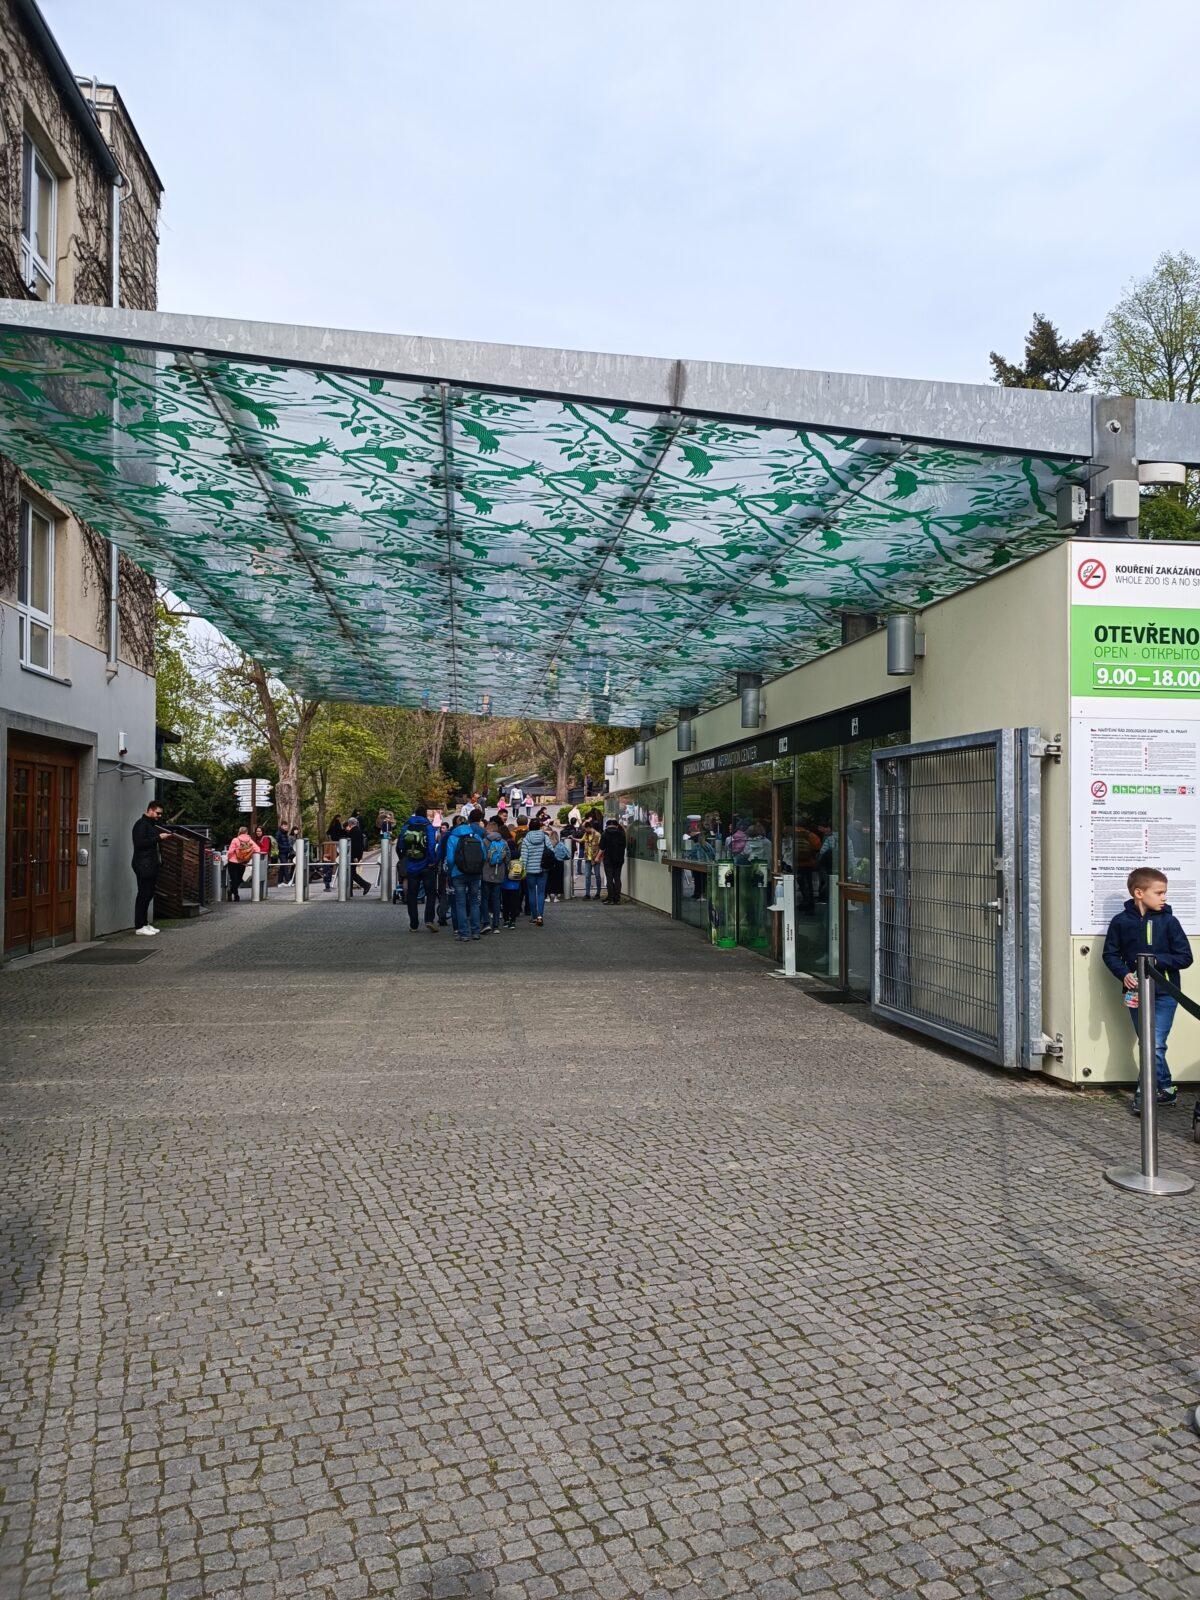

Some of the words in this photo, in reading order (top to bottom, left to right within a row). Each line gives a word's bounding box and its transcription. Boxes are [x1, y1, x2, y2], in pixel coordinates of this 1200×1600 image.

[1115, 564, 1153, 575] KOUŘENÍ
[1156, 565, 1200, 576] ZAKÁZÁNO
[1115, 576, 1142, 584] WHOLE
[1145, 577, 1160, 585] ZOO
[1162, 577, 1169, 585] IS
[1172, 578, 1177, 586] A
[1179, 578, 1190, 586] NO
[1094, 622, 1200, 645] OTEVŘENO
[1094, 646, 1128, 658] OPEN
[1141, 647, 1200, 660] ОТКРЫТО
